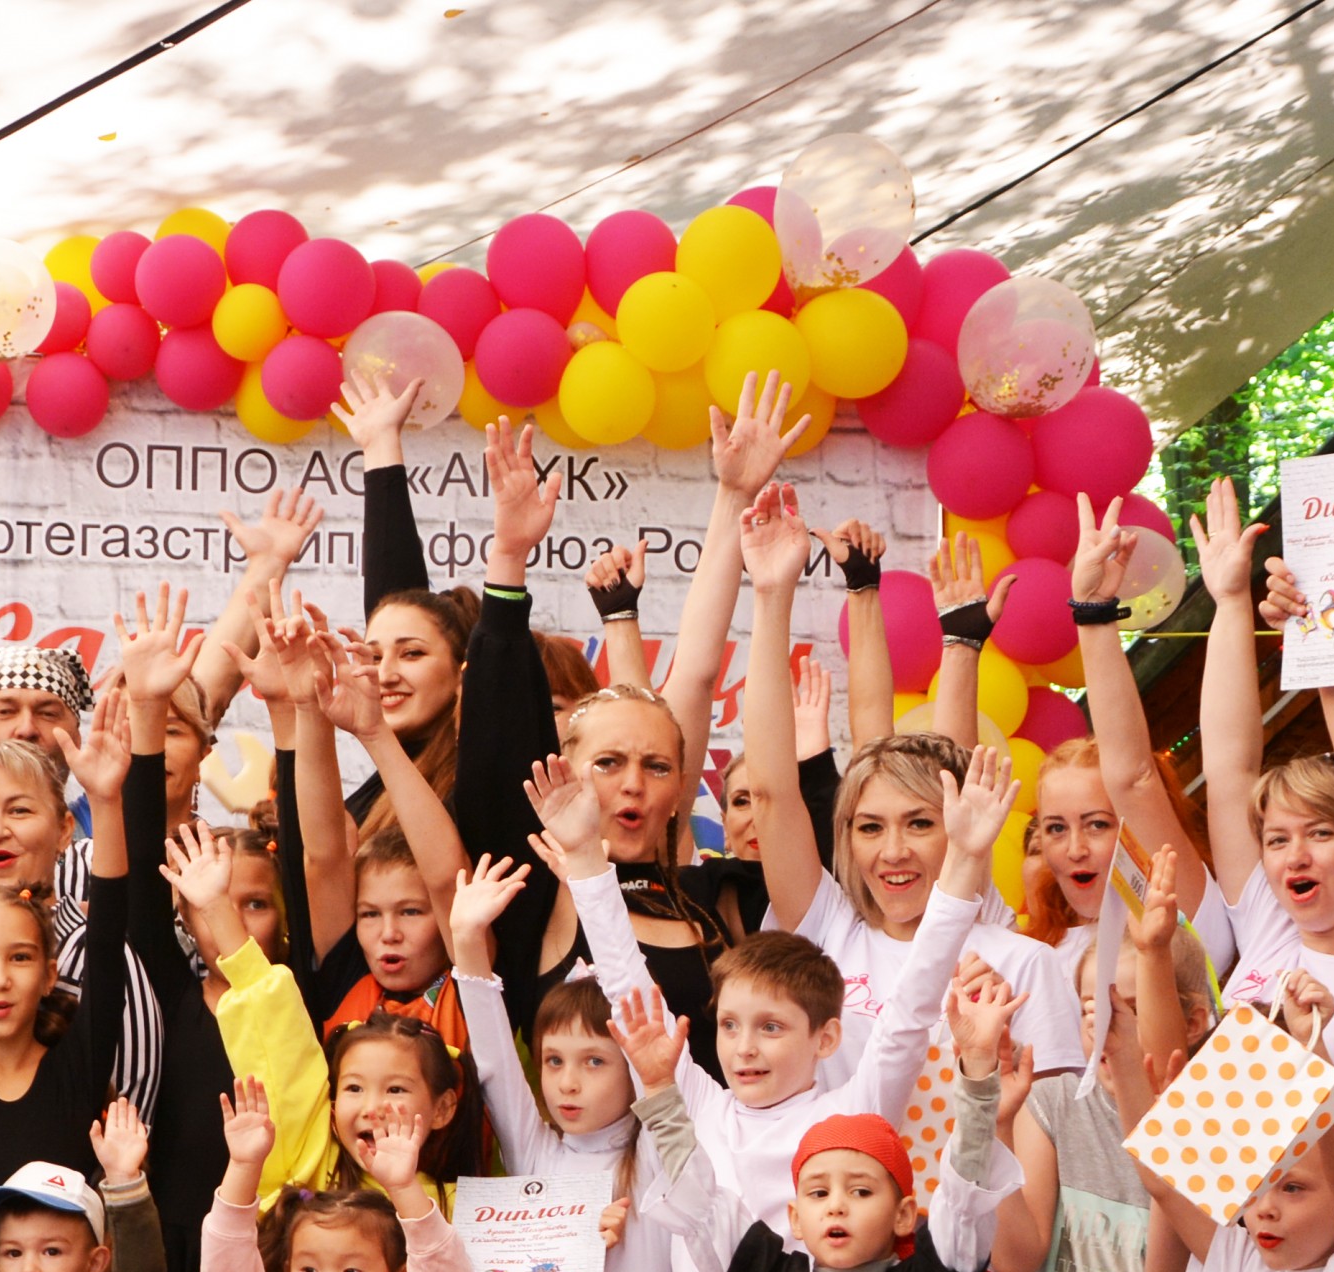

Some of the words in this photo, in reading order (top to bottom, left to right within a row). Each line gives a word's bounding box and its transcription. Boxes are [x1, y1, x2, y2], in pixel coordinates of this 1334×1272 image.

[96, 441, 277, 494] ОППО
[407, 451, 629, 501] «АХК»
[638, 526, 832, 577] Рои
[474, 1203, 586, 1223] Диплом
